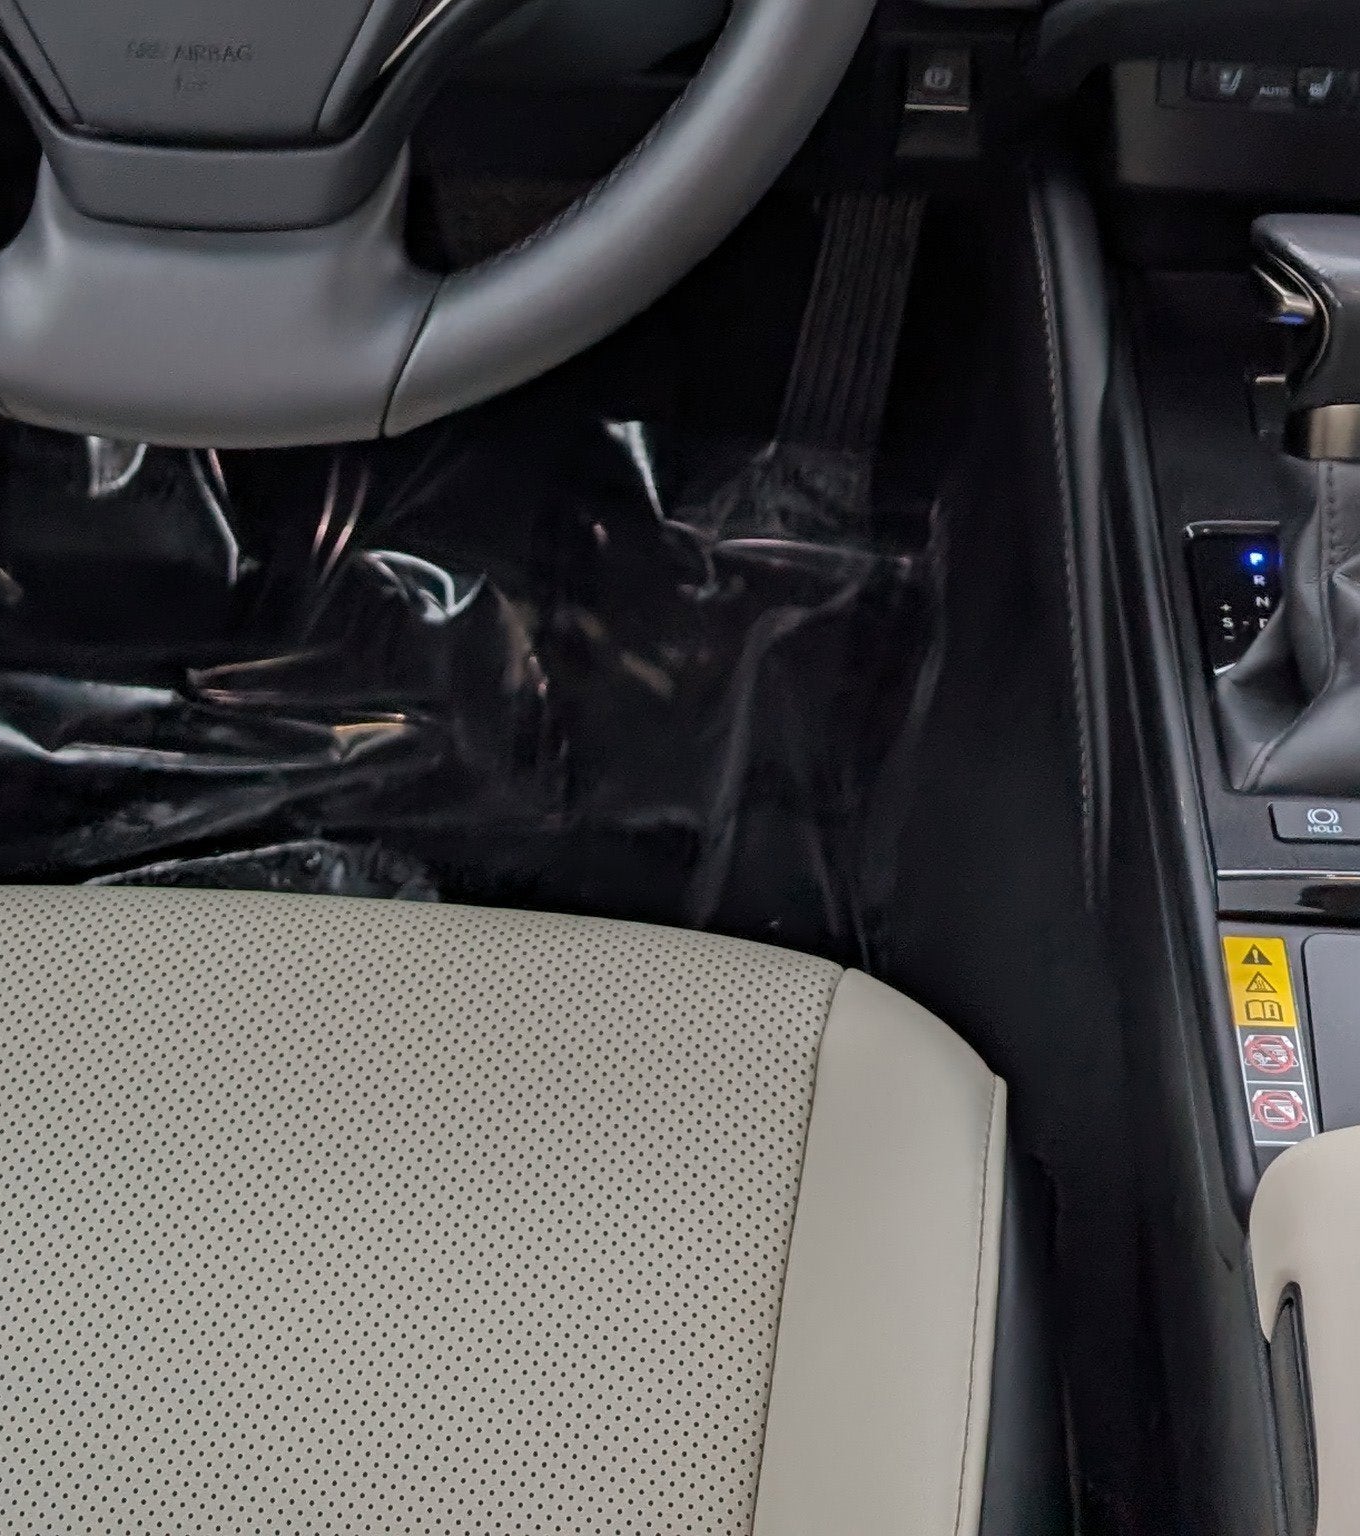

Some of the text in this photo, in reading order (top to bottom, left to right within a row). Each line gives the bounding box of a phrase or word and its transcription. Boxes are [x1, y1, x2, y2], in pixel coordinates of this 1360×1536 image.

[1249, 551, 1265, 566] P
[1252, 574, 1267, 586] R
[1255, 595, 1271, 608] N
[1221, 616, 1235, 629] S
[1307, 824, 1343, 835] HOLD
